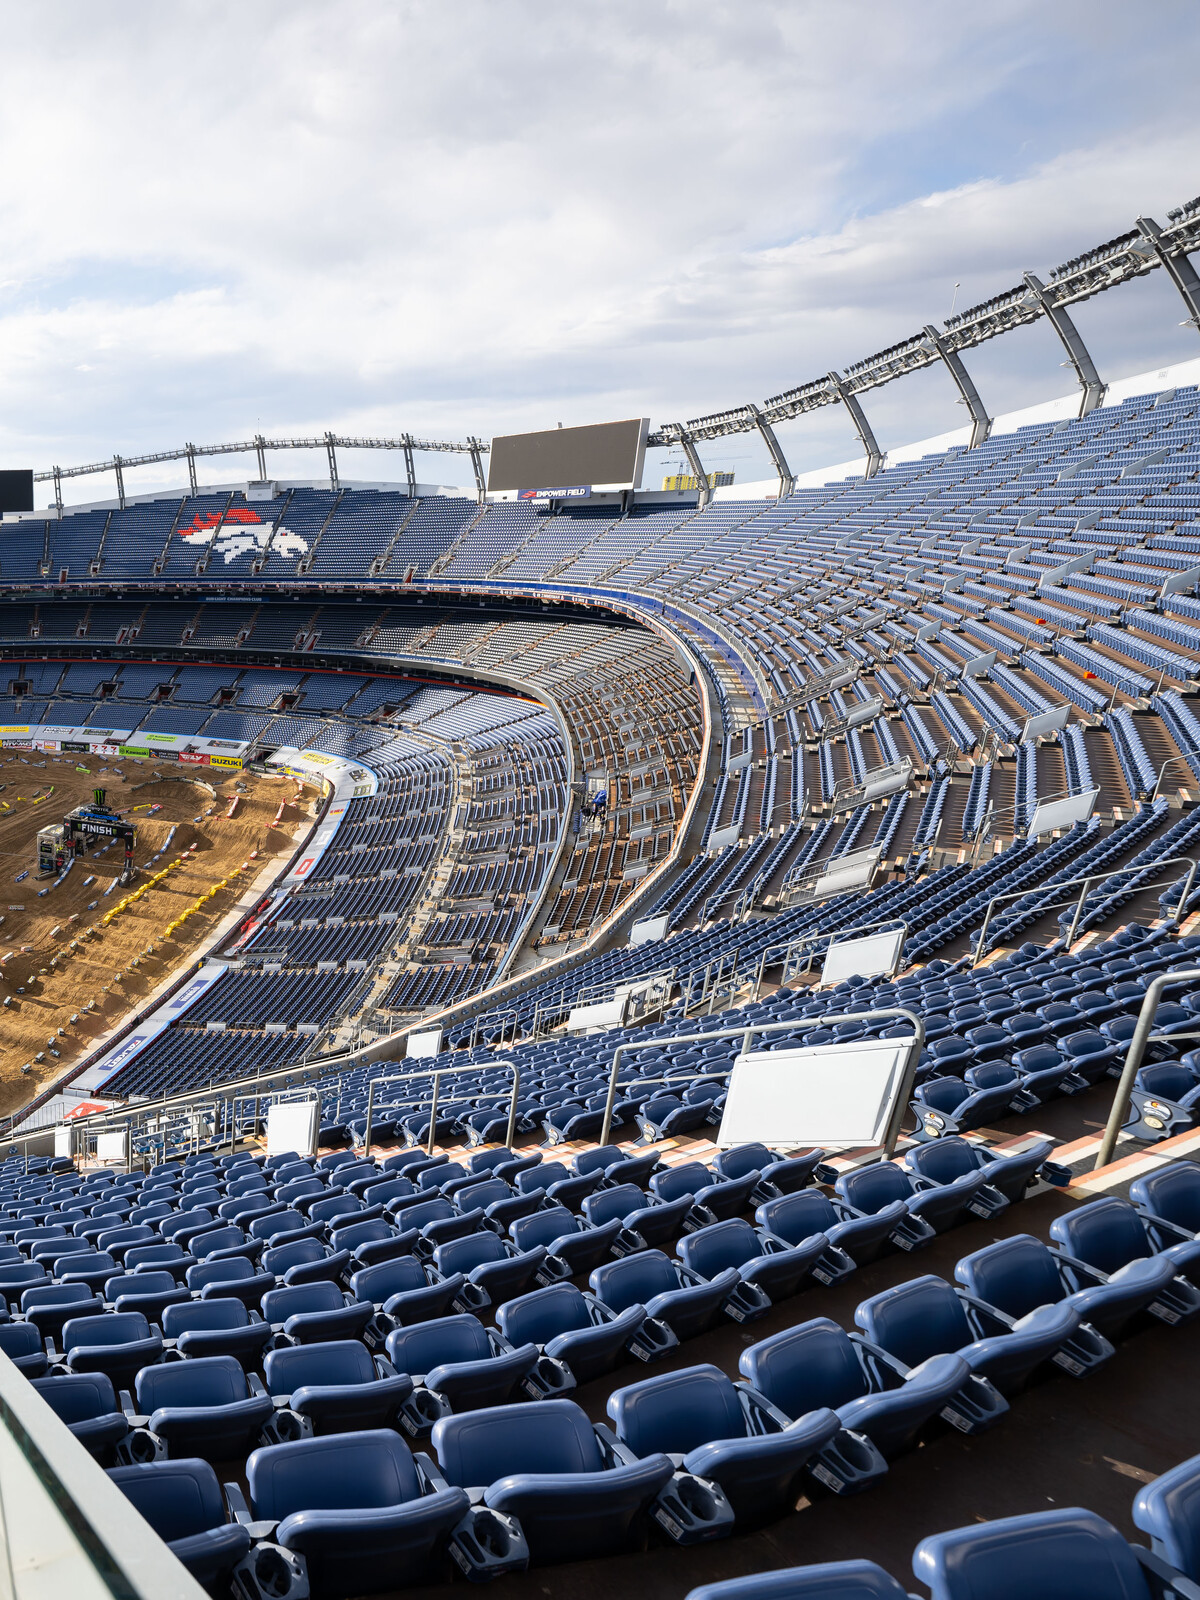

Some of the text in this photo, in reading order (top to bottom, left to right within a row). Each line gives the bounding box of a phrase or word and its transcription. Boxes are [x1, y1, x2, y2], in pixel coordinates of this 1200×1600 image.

[536, 488, 586, 498] EMPOWER FIELD
[212, 758, 241, 766] SUZUKI
[82, 824, 112, 835] FINISH
[108, 1040, 141, 1067] FALKEN
